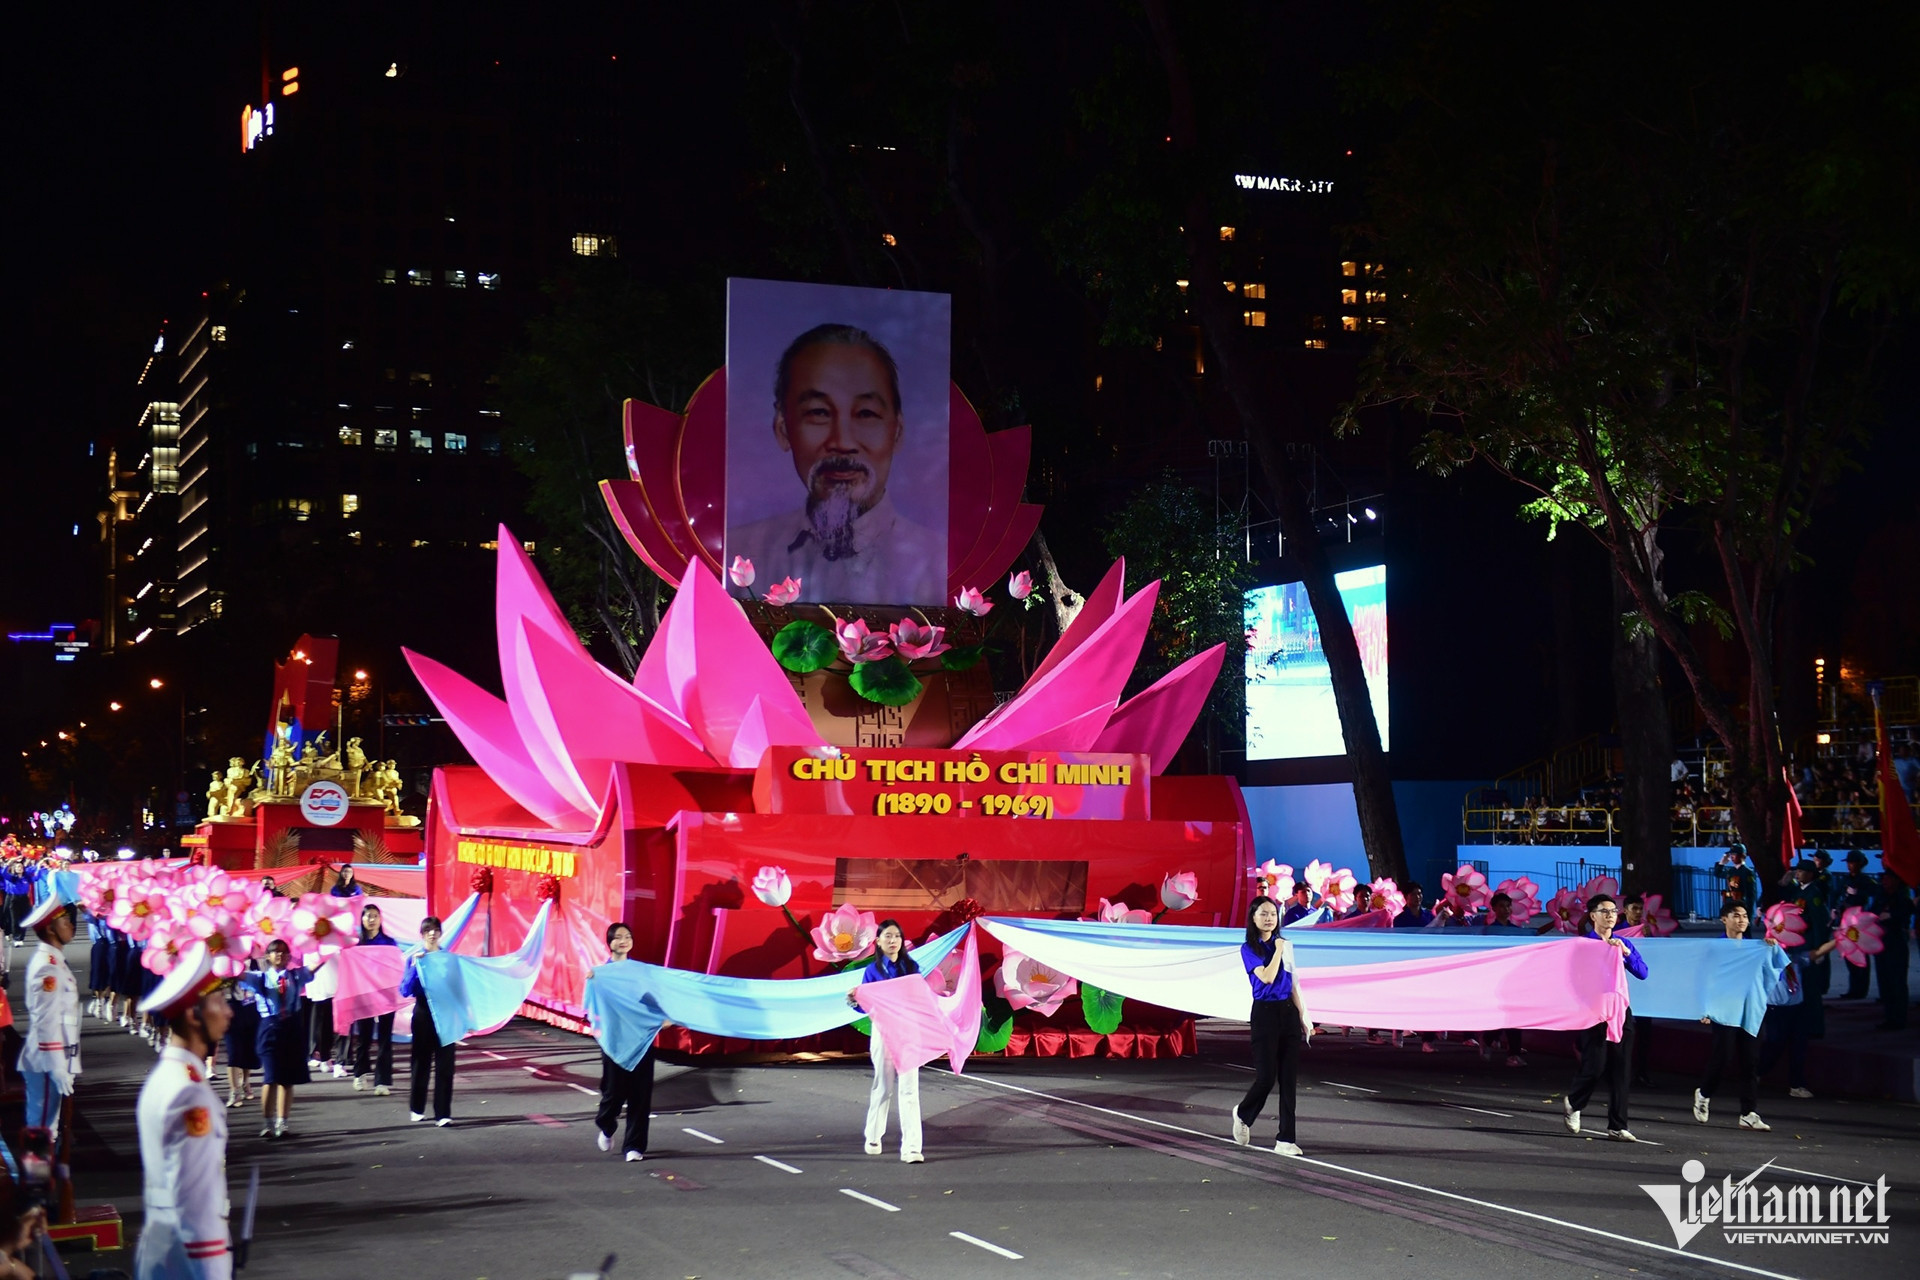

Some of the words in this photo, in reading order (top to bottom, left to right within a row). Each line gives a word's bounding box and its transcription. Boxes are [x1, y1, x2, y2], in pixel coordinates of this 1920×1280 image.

[793, 753, 856, 780] CHỦ
[866, 760, 935, 786] TỊCH
[944, 753, 990, 782] HỒ
[1000, 758, 1047, 784] CHÍ
[1056, 764, 1131, 786] MINH
[877, 793, 951, 817] (1890
[981, 794, 1053, 820] 1969)
